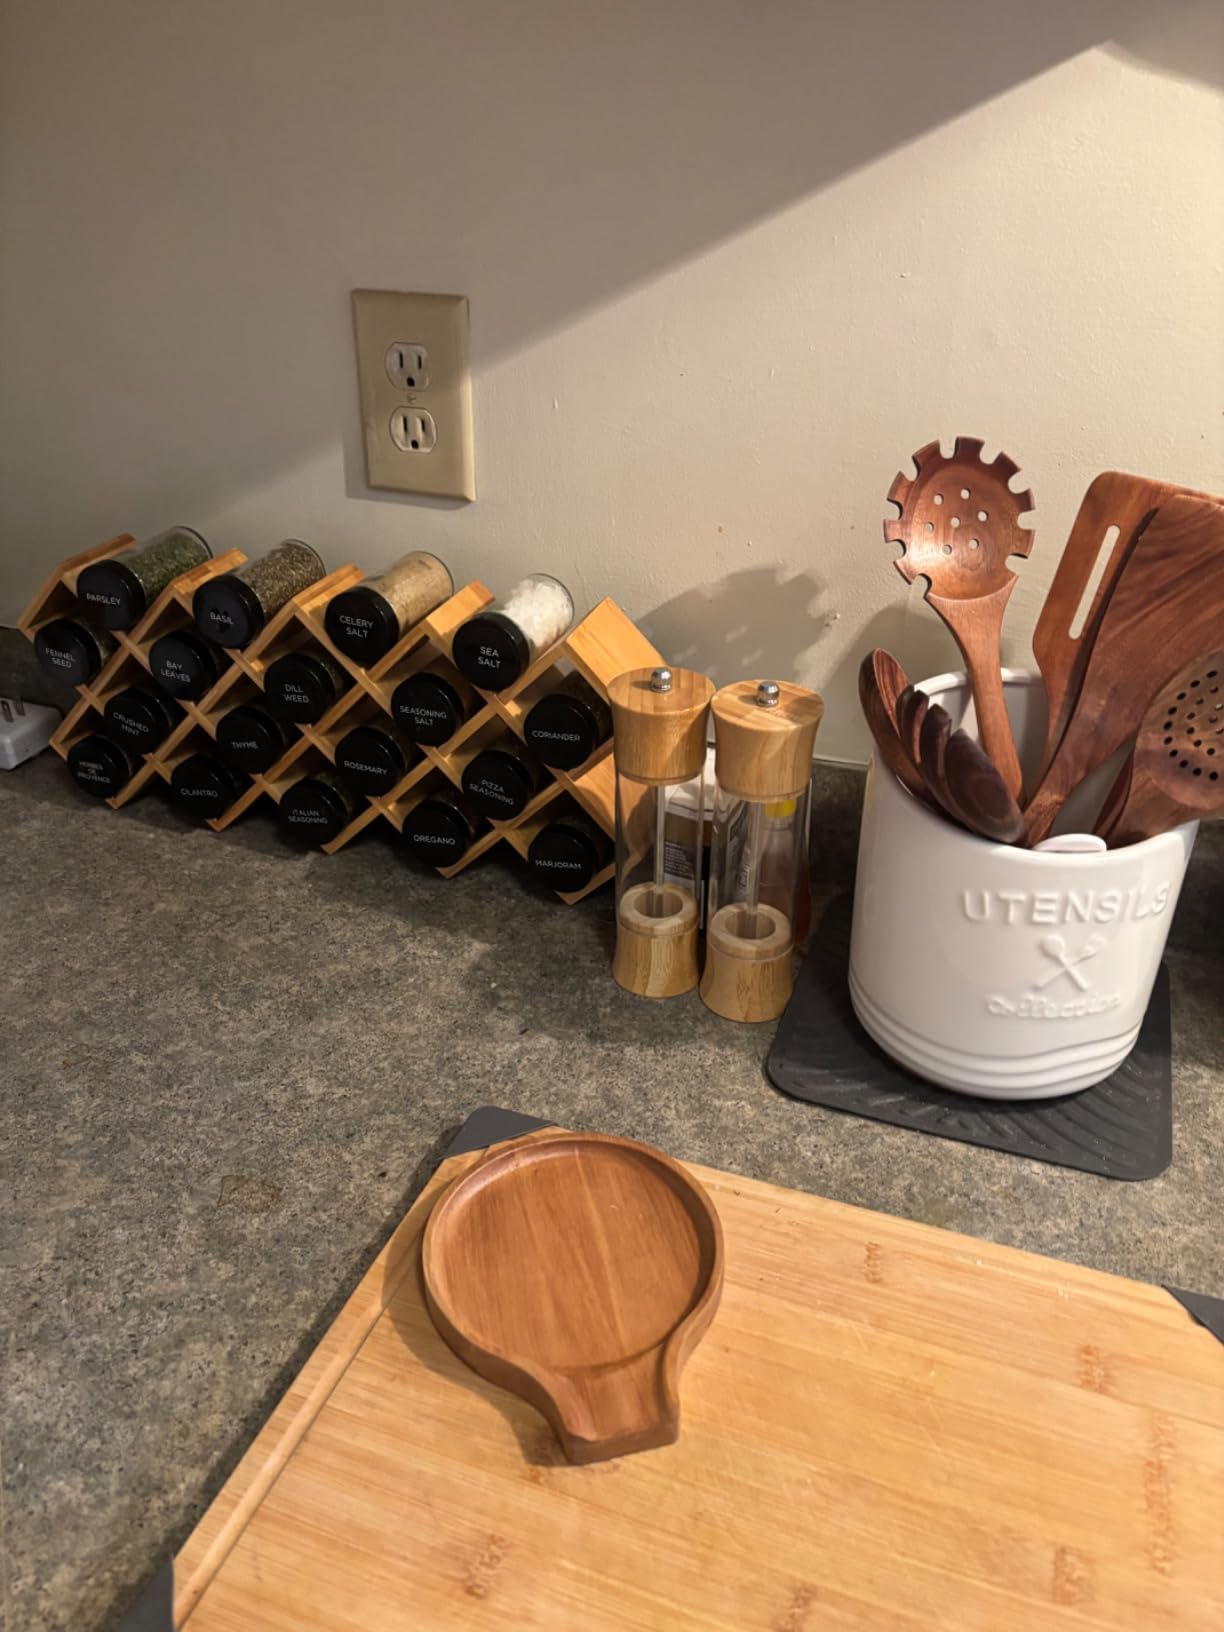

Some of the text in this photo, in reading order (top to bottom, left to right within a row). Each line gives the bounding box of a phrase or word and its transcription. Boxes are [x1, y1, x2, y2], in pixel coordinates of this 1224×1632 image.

[86, 592, 121, 606] PARSLEY
[339, 615, 373, 630] CELERY
[345, 626, 369, 639] SALT
[45, 647, 76, 662] FENNEL
[480, 646, 500, 657] SEA
[51, 657, 72, 668] SEED
[166, 660, 183, 671] BAY
[478, 656, 501, 669] SALT
[161, 668, 191, 683] LEAVES
[285, 684, 304, 693] DILL
[284, 694, 310, 704] WEED
[400, 705, 447, 719] SEASONING
[113, 712, 150, 733] CRUSHED
[414, 716, 434, 726] SALT
[121, 723, 141, 737] MINT
[532, 730, 581, 742] CORIANDER
[231, 741, 258, 750] THYME
[344, 760, 388, 775] ROSEMARY
[481, 779, 505, 794] PIZZA
[180, 788, 218, 798] CILANTRO
[469, 783, 514, 806] SEASONING
[292, 809, 320, 818] ITALIAN
[288, 815, 328, 825] SEASONING
[413, 834, 456, 846] OREGANO
[535, 859, 582, 870] MARJORAM
[962, 880, 1171, 925] UTENSILS
